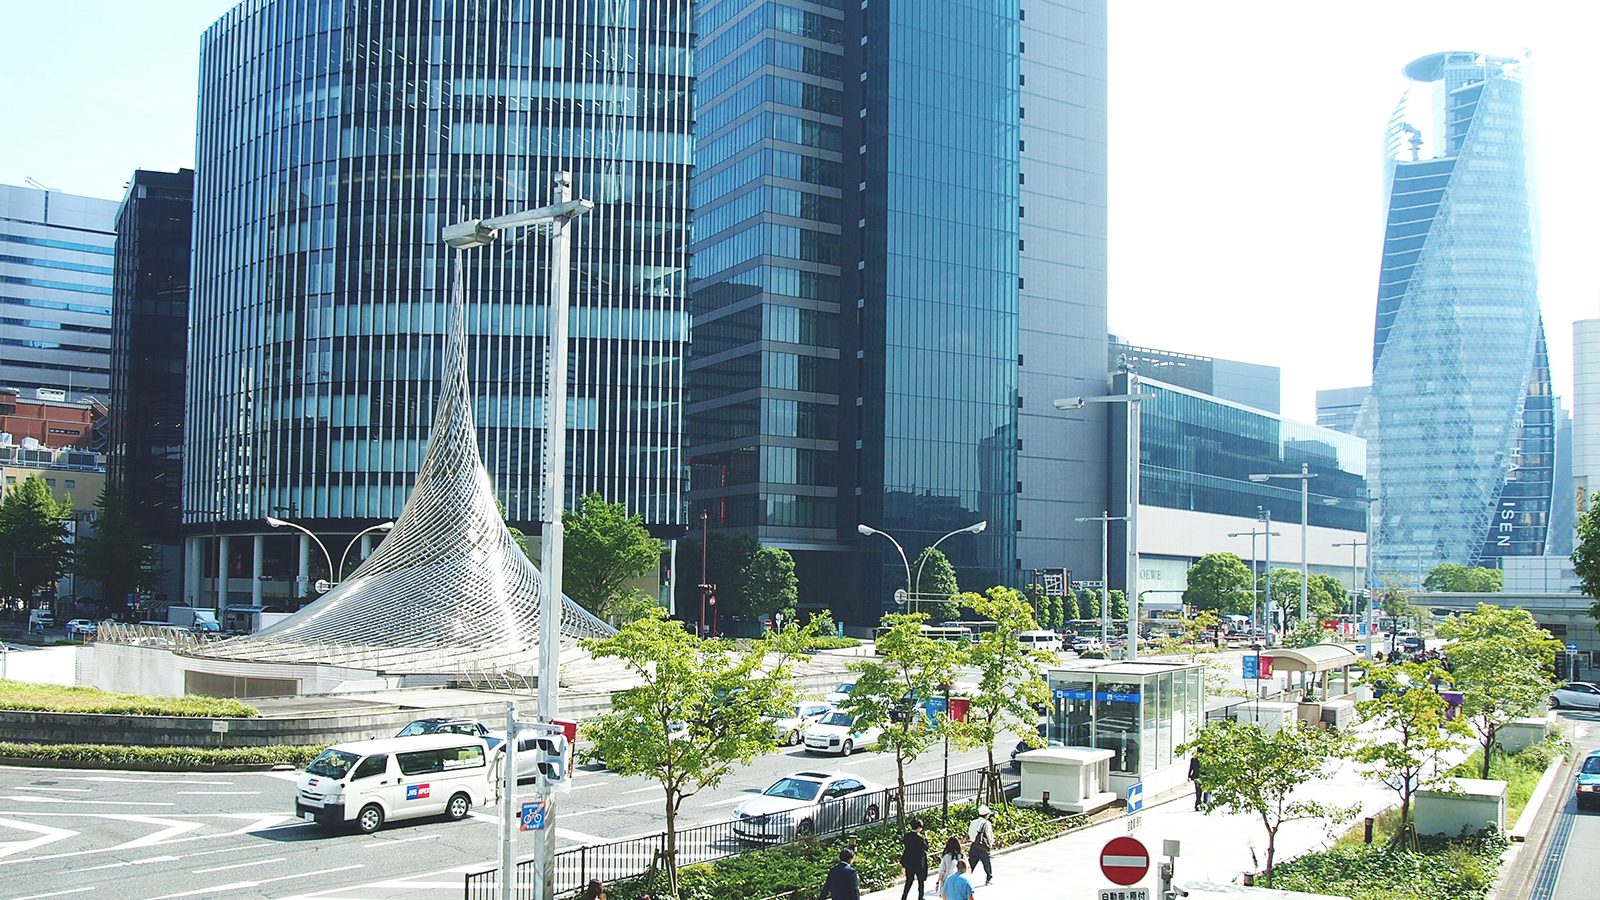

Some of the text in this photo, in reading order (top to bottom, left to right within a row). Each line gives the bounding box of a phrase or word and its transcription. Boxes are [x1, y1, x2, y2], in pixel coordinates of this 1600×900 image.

[1504, 447, 1520, 486] HAL
[1497, 502, 1515, 547] ISEN
[1139, 569, 1161, 580] OEWE
